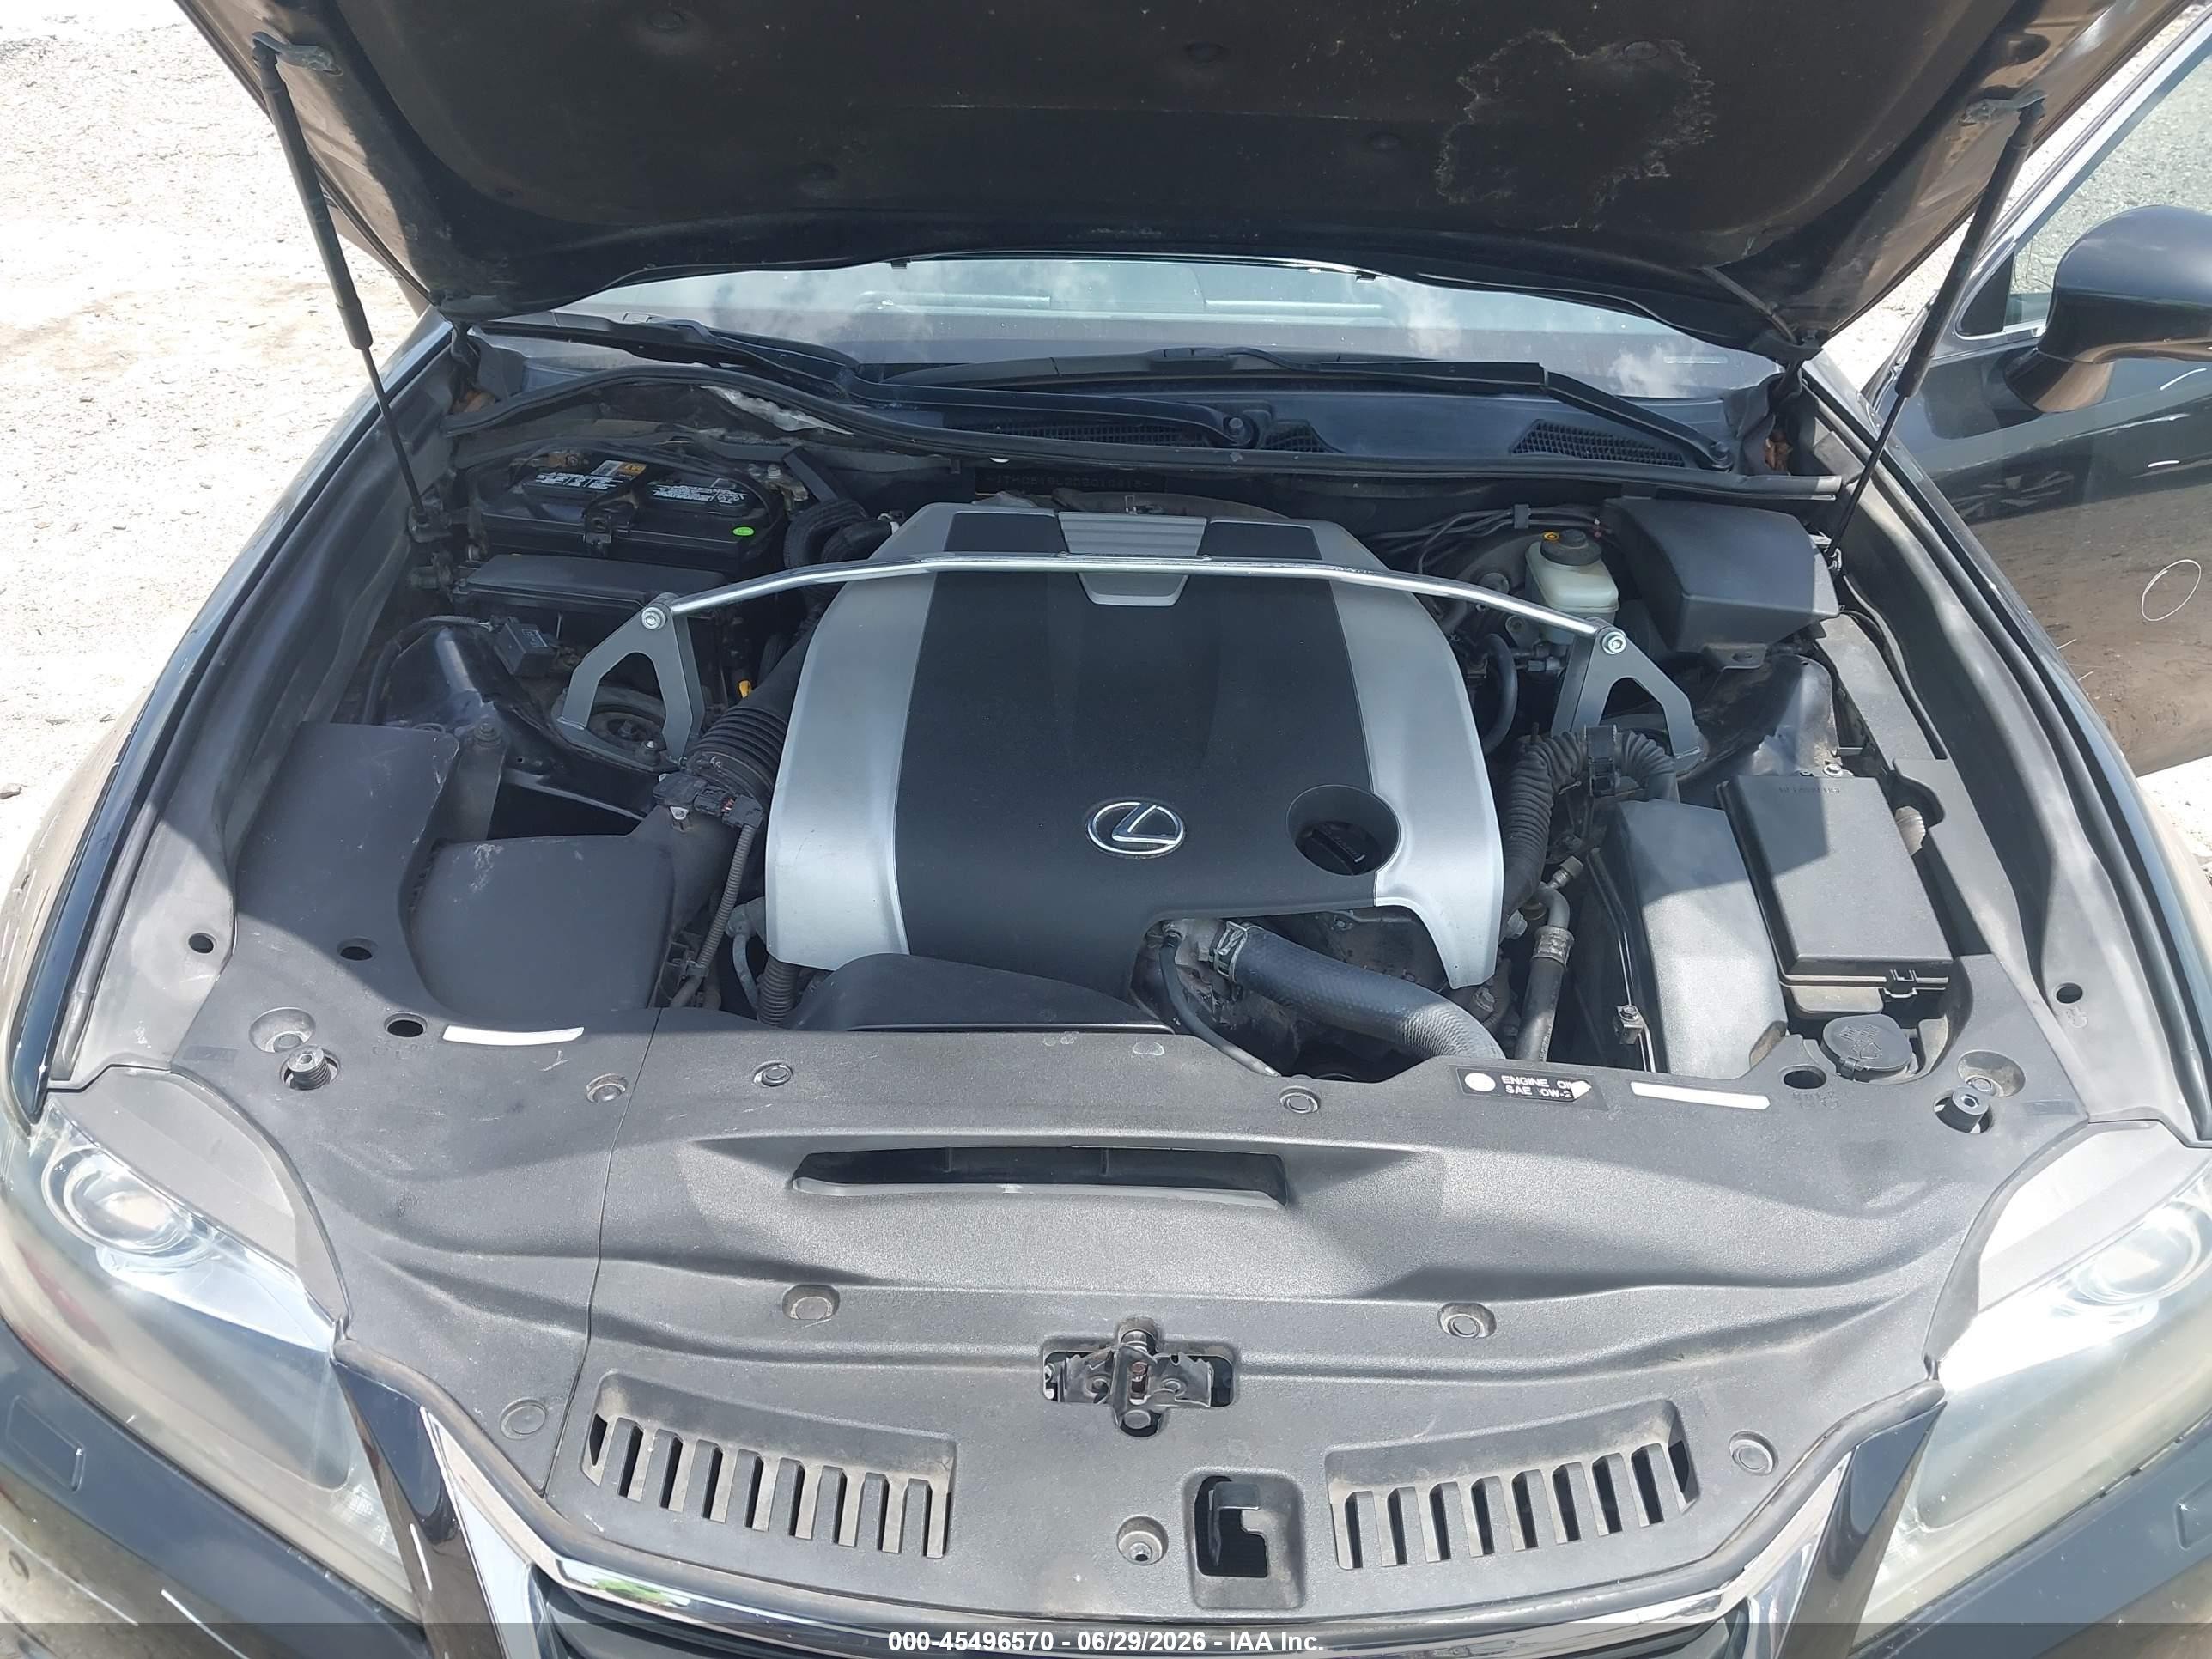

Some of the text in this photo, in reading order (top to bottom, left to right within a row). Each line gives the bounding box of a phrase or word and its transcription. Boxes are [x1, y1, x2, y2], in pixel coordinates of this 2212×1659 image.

[1501, 1075, 1572, 1090] ENGINE OI
[1505, 1085, 1533, 1096] SAE
